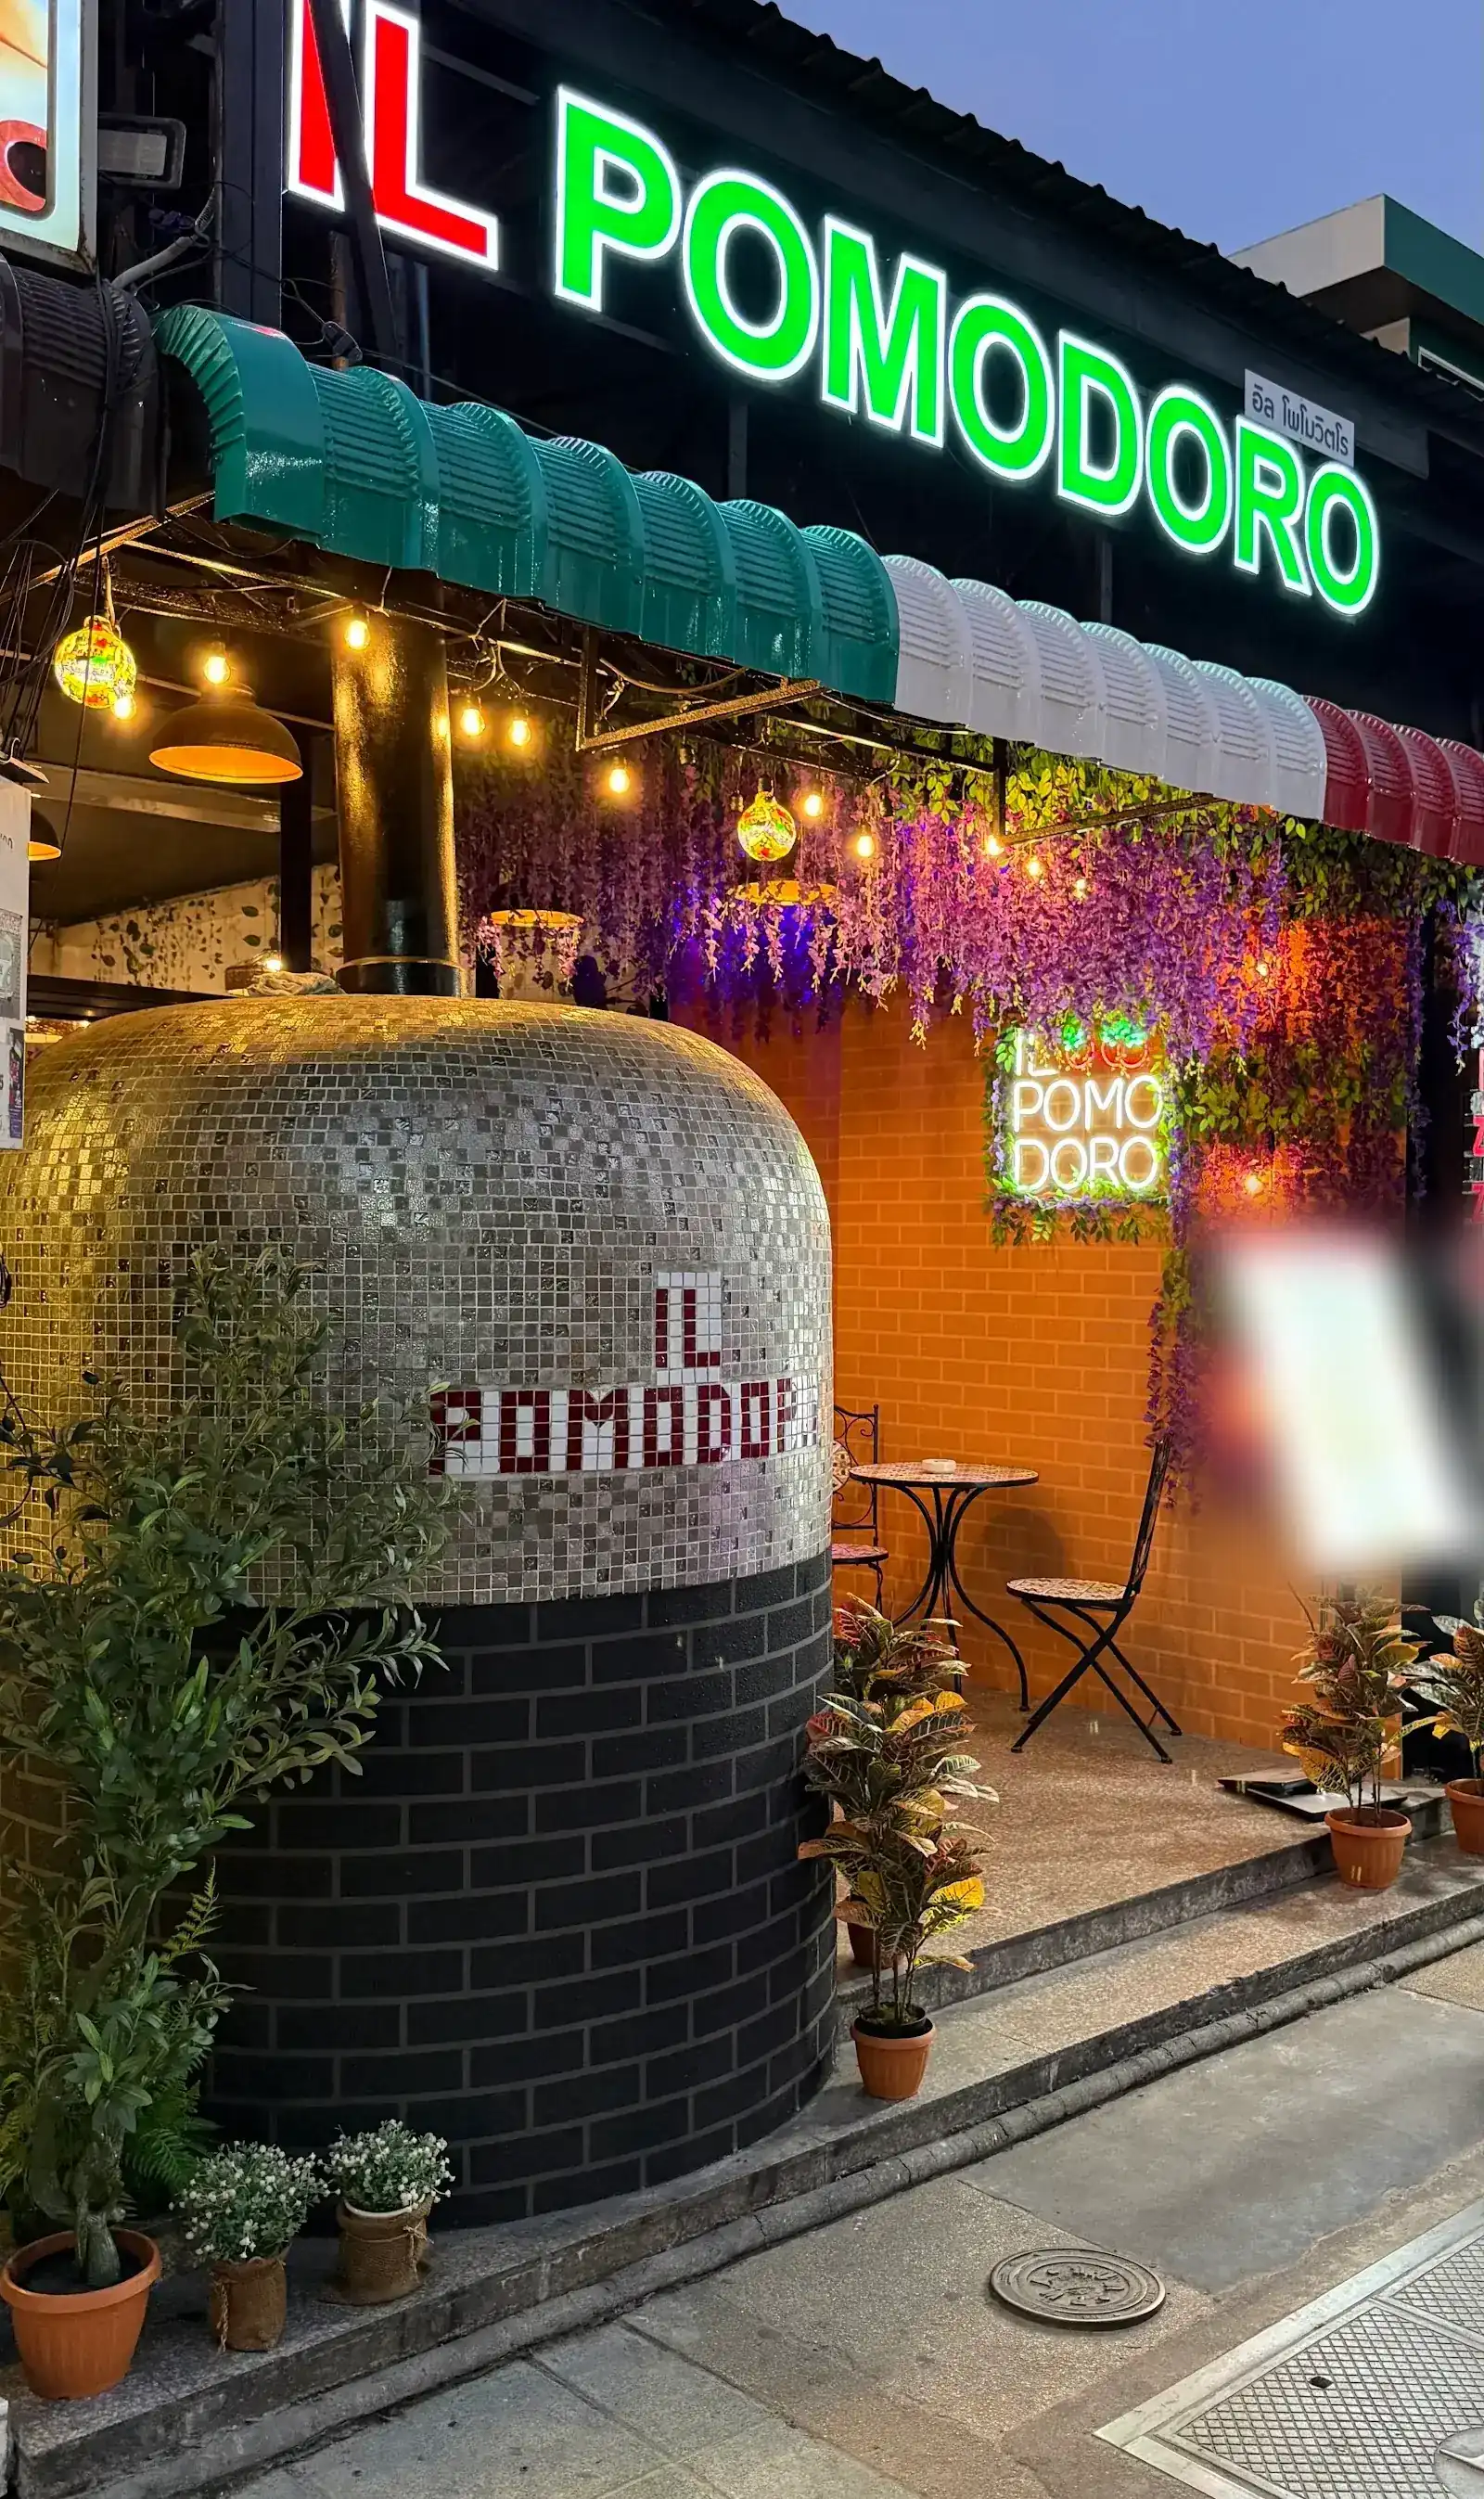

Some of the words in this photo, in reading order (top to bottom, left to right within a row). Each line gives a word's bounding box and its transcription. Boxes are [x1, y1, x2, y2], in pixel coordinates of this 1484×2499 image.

[288, 0, 499, 271] IL
[554, 83, 1380, 617] POMODORO
[1014, 1028, 1059, 1077] IL
[1013, 1074, 1164, 1133] POMO
[1013, 1135, 1158, 1193] DORO
[656, 1288, 721, 1367] IL
